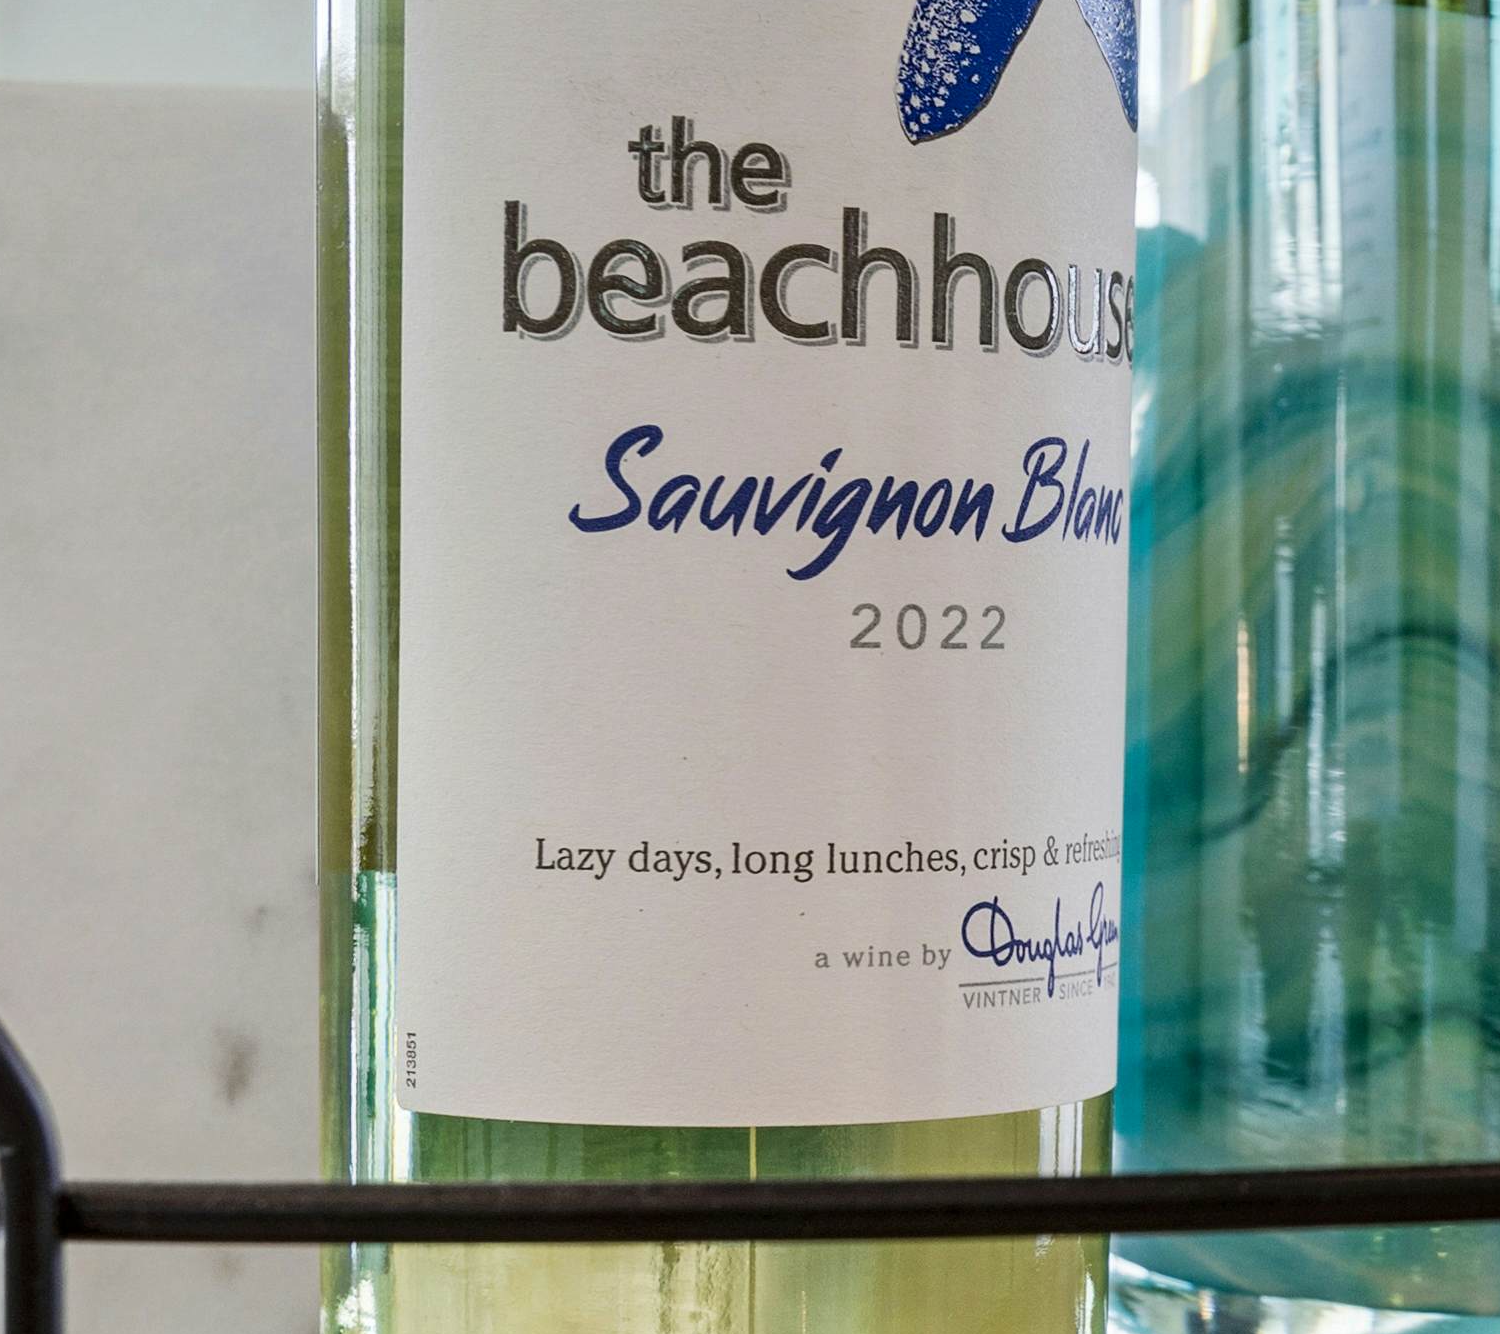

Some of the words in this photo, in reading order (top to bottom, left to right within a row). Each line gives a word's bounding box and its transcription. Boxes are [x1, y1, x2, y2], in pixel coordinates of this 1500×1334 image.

[627, 114, 792, 214] the
[567, 423, 997, 581] Sauvignon
[1001, 435, 1125, 545] Blanc
[848, 602, 1008, 652] 2022
[534, 837, 616, 881] Lazy
[627, 840, 724, 882] days,
[731, 841, 815, 884] long
[826, 841, 967, 877] lunches,
[973, 838, 1037, 877] crisp
[1043, 834, 1060, 867] &
[814, 951, 831, 969] a
[842, 945, 911, 969] wine
[921, 943, 953, 971] by
[960, 894, 1084, 999] Douglas
[962, 986, 1042, 1010] VINTNER
[1058, 979, 1094, 1001] SINCE
[405, 1031, 418, 1089] 213851
